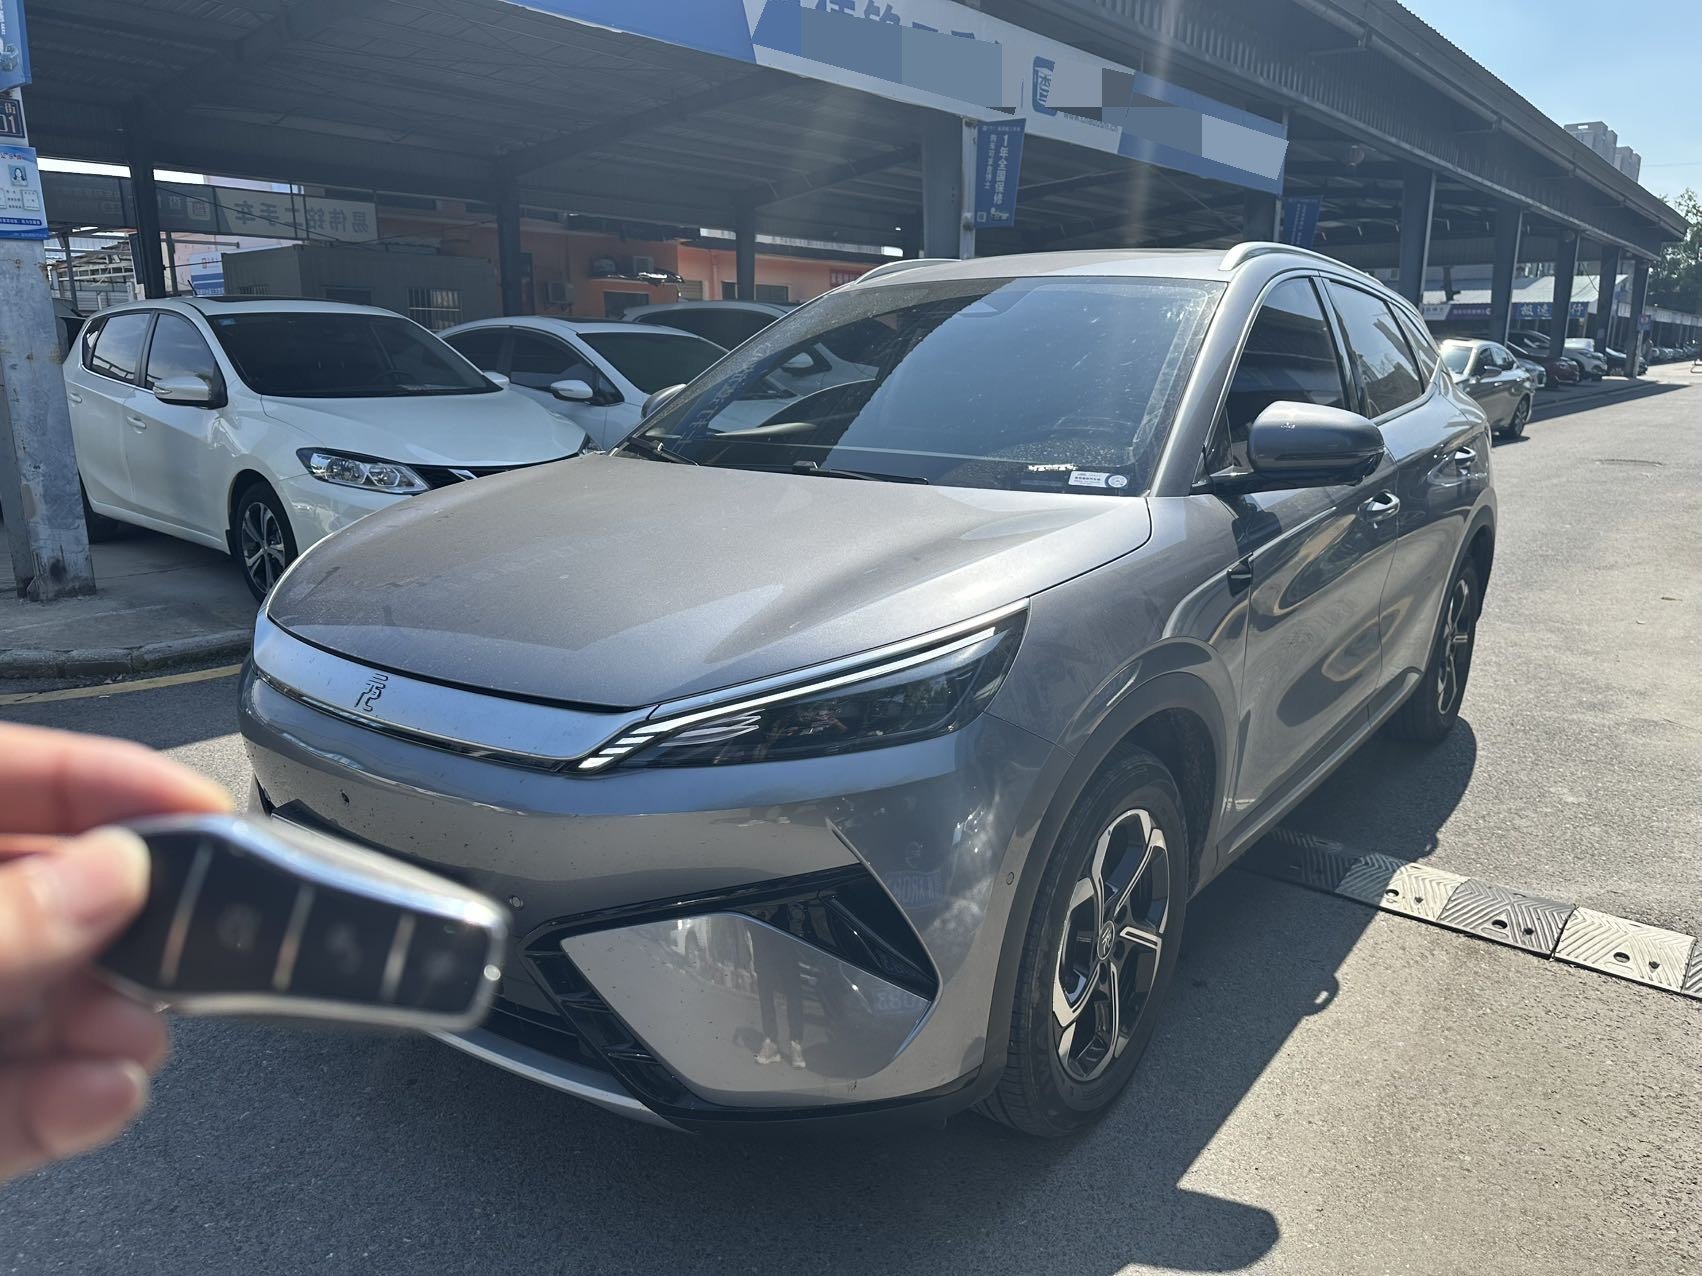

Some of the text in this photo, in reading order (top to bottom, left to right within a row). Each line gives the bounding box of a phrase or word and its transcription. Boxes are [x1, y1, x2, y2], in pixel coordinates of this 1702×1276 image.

[993, 134, 1009, 205] 1年全国保修
